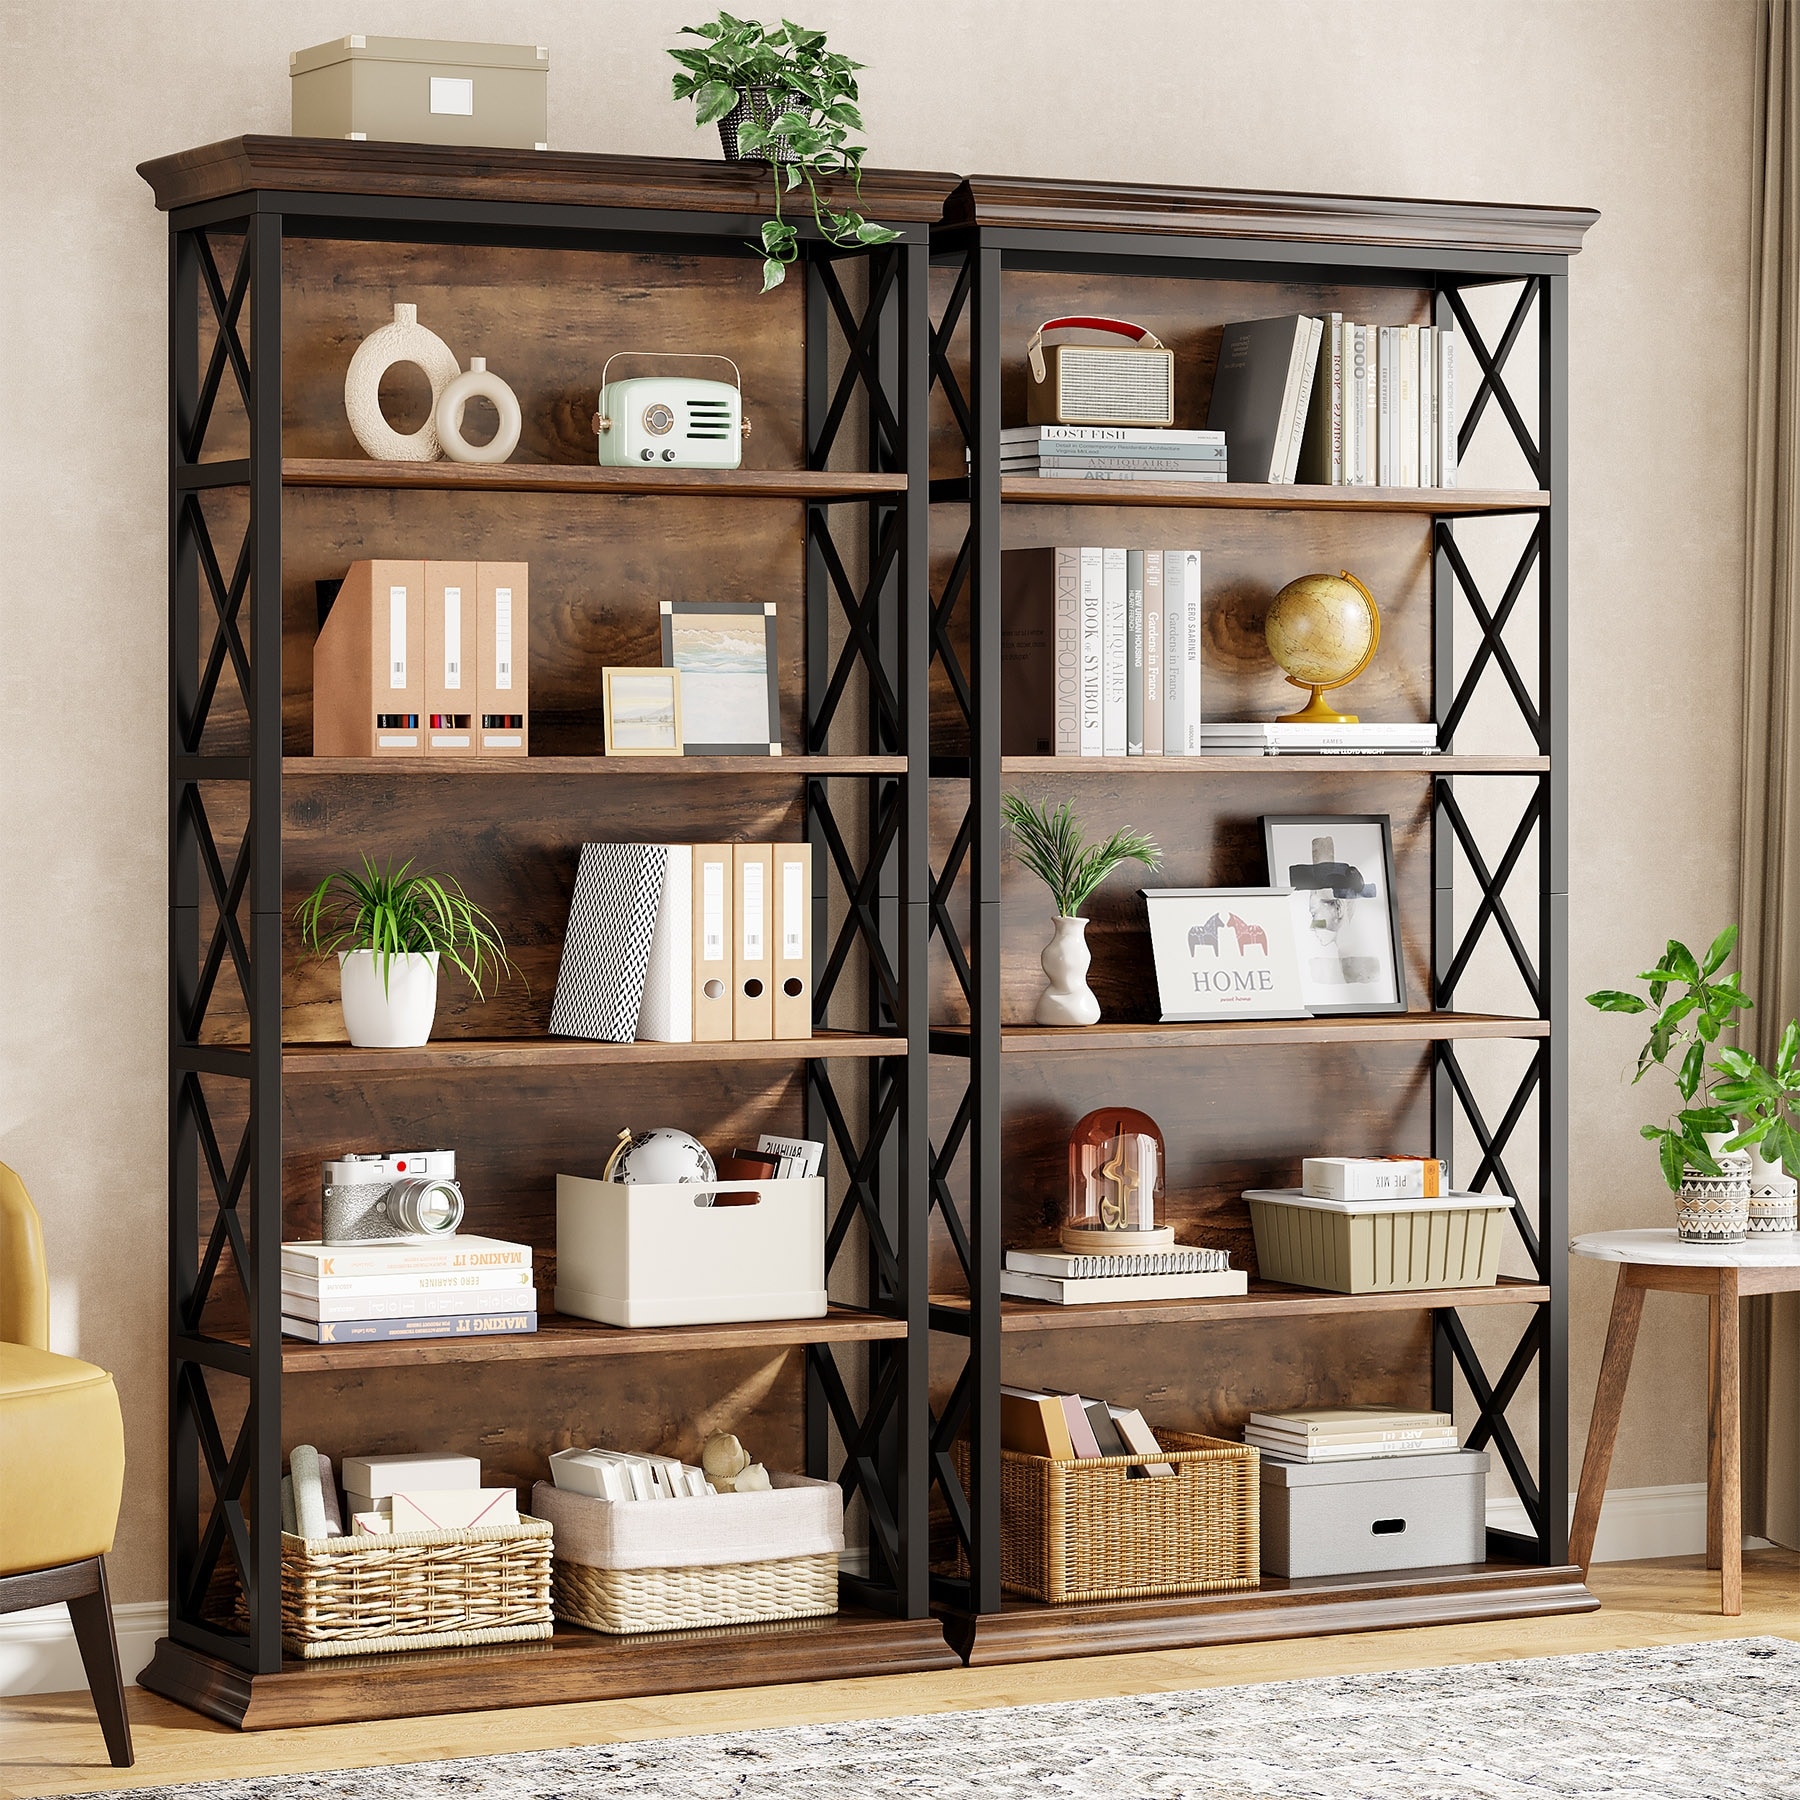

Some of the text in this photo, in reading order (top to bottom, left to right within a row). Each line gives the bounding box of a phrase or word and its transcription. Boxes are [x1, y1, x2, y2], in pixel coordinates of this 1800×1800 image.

[1047, 428, 1126, 440] LOST FISH
[1088, 458, 1180, 467] ANTIQUAIRES
[1084, 471, 1113, 480] ART
[1058, 552, 1077, 622] ALEXEY
[1085, 598, 1098, 638] BOOK
[1110, 601, 1124, 703] ANTIQUAIRES
[1148, 612, 1159, 700] Gardens in France
[1169, 612, 1180, 700] Gardens in France
[1058, 628, 1077, 744] BRODOVITCH
[1085, 655, 1098, 729] SYMBOLS
[1192, 970, 1274, 992] HOME
[1376, 1175, 1407, 1187] PIE MIX
[453, 1252, 522, 1266] MAKING IT
[419, 1276, 479, 1288] EERO SAARINEN
[456, 1316, 527, 1332] MAKING IT
[1399, 1430, 1423, 1439] ART
[1400, 1441, 1423, 1449] ART
